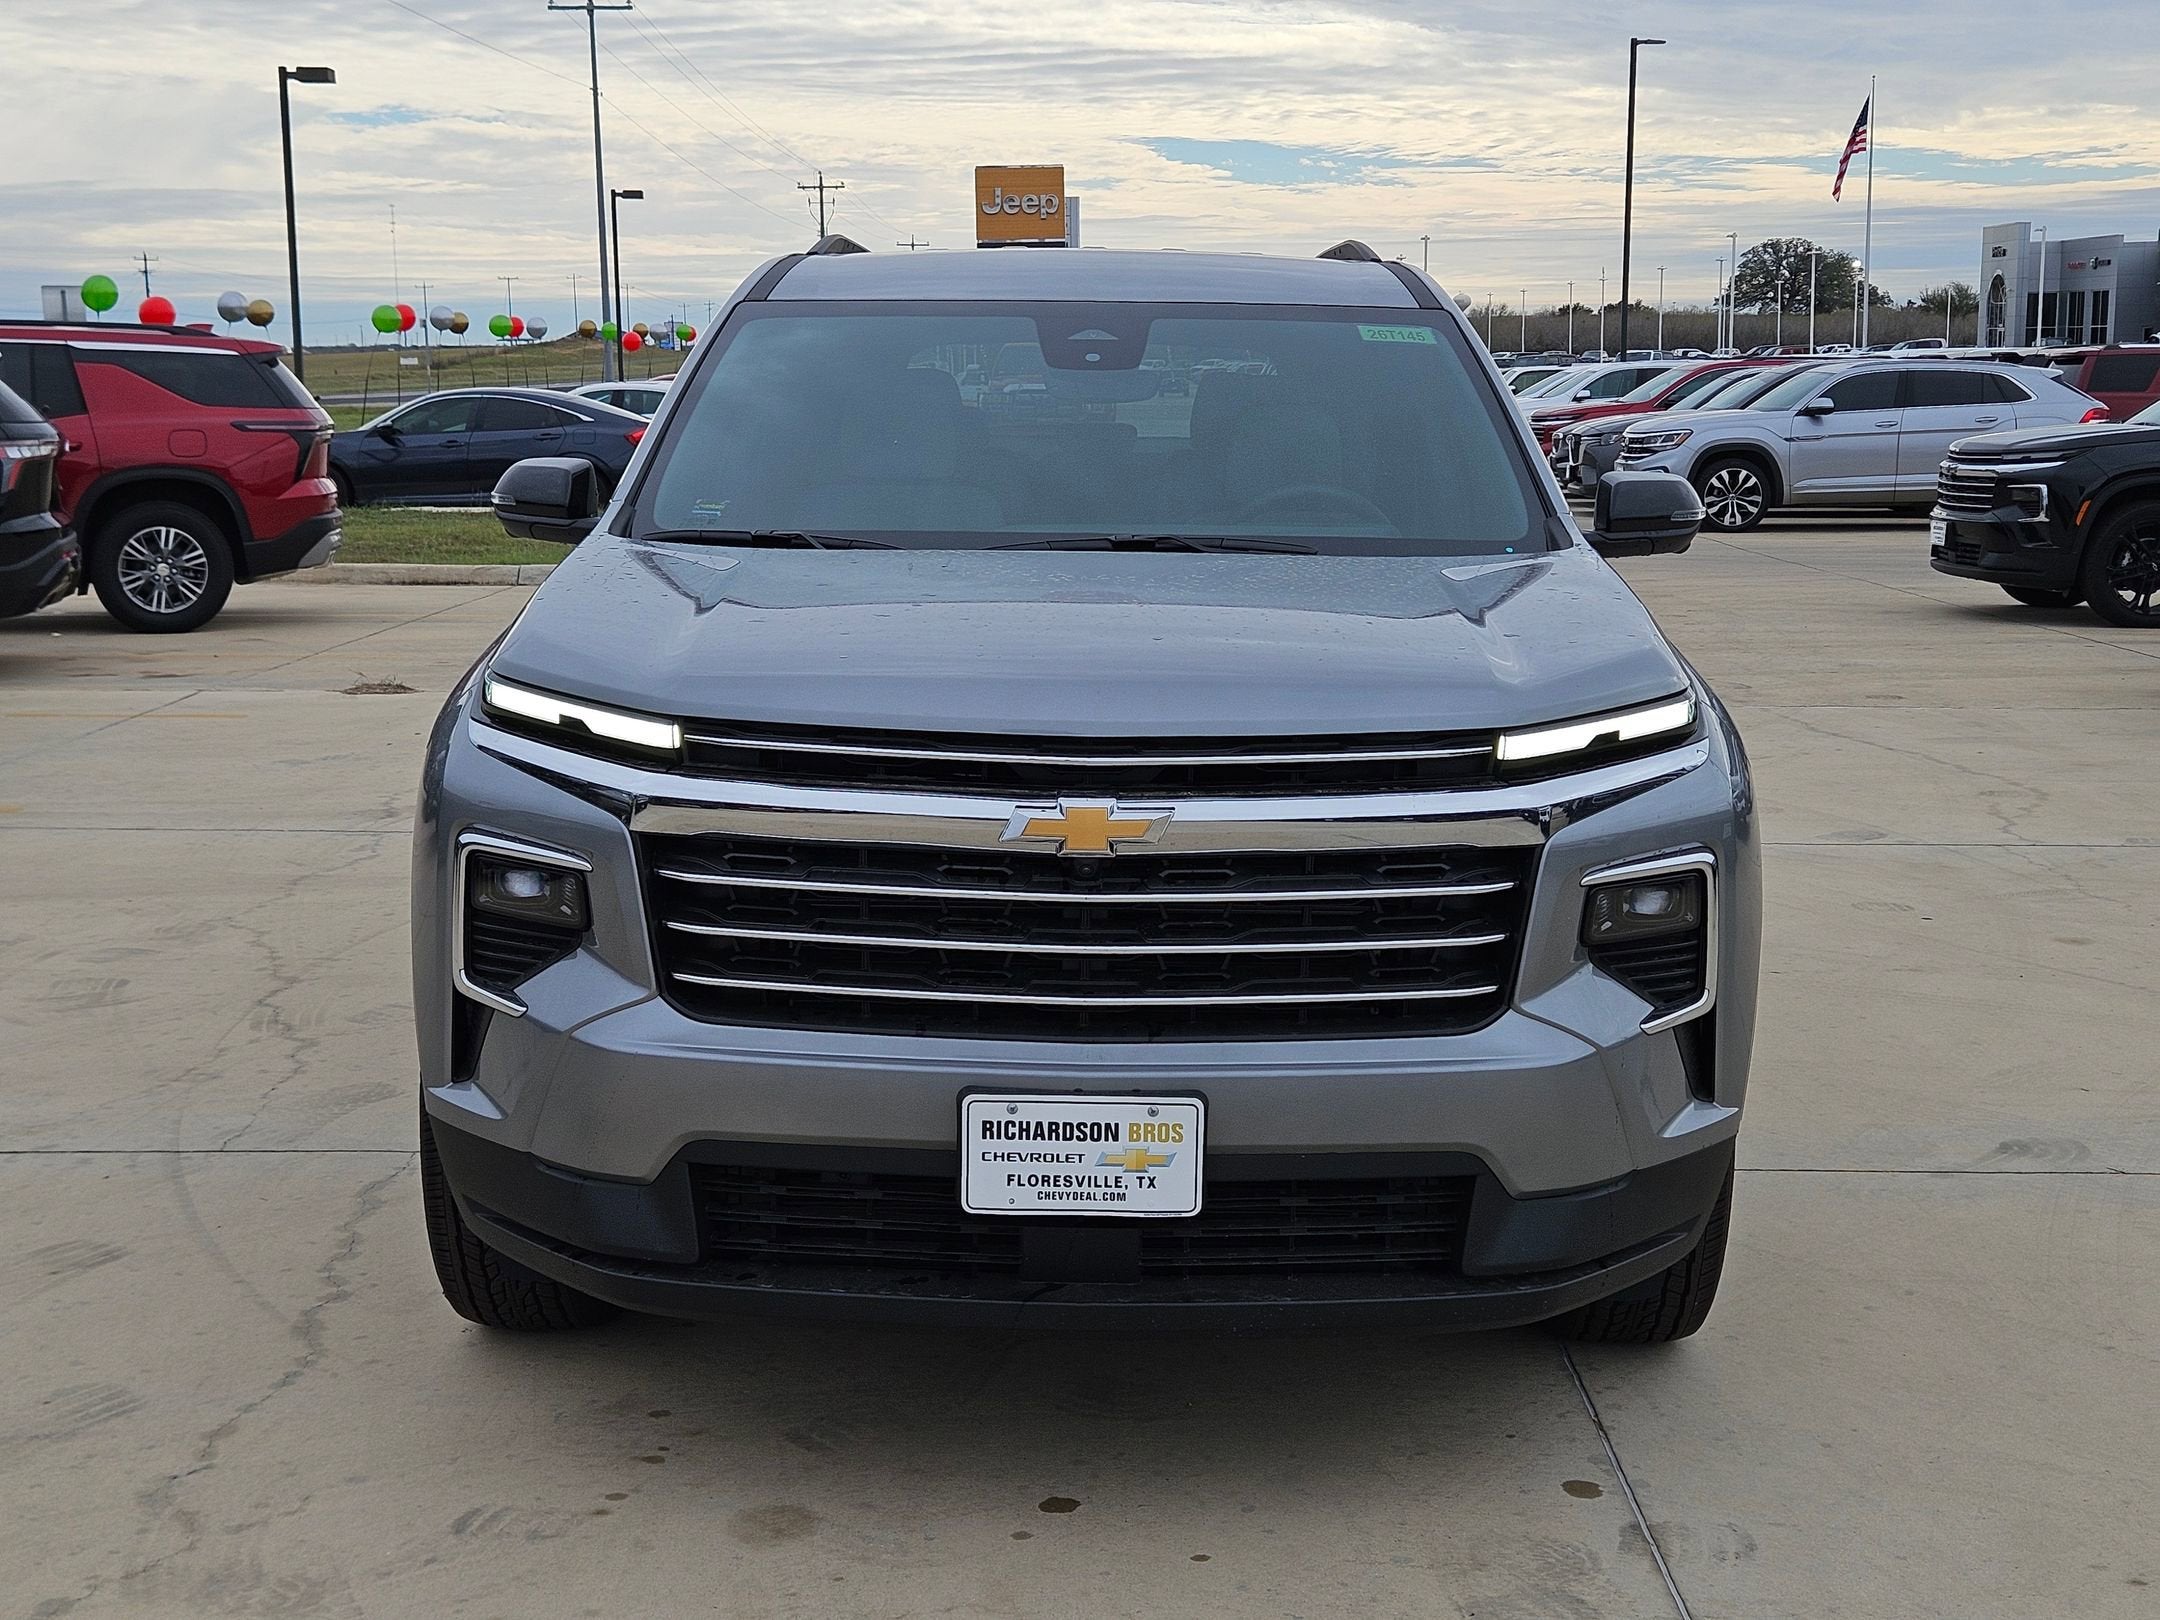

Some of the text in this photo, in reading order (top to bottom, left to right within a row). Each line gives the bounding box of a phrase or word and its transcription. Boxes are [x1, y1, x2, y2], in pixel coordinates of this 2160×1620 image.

[982, 187, 1059, 220] Jeep
[1367, 329, 1426, 342] 26T145
[981, 1120, 1184, 1143] RICHARDSON BROS
[981, 1151, 1086, 1164] CHEVROLET
[1006, 1174, 1157, 1190] FLORESVILLE, TX
[1037, 1190, 1126, 1202] CHEVYDEAL.COM
